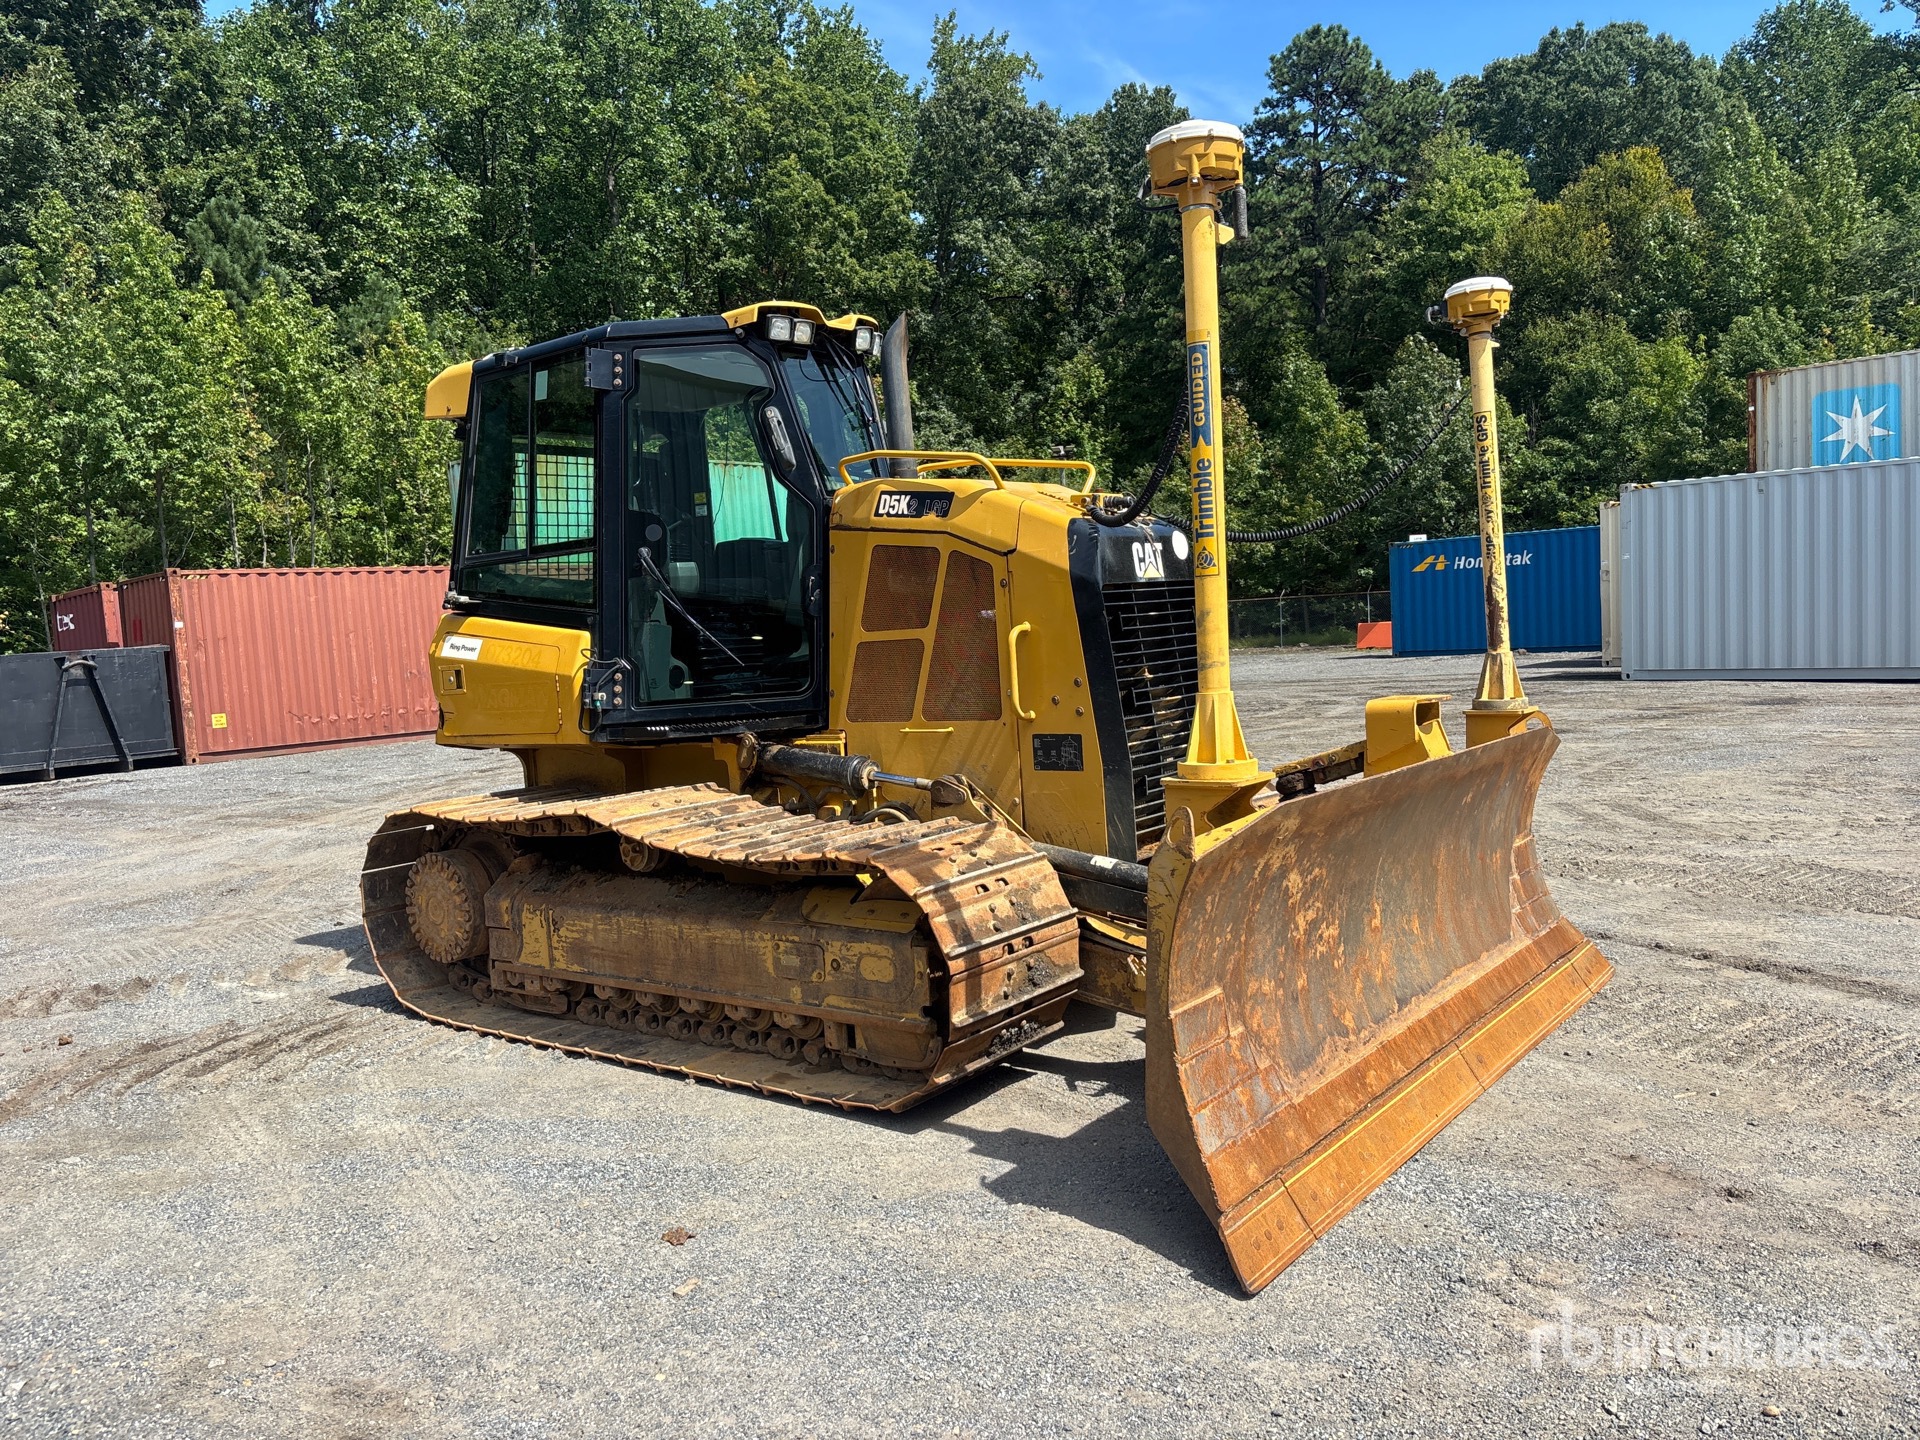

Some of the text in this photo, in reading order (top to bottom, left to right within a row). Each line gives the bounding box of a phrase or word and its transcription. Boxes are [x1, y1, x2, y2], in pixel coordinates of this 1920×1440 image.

[1191, 352, 1205, 427] GUIDED
[1475, 414, 1488, 443] GPS
[924, 499, 949, 516] LGP
[1194, 457, 1214, 543] Trimble
[1131, 541, 1165, 578] CAT
[449, 642, 477, 653] Ring Power
